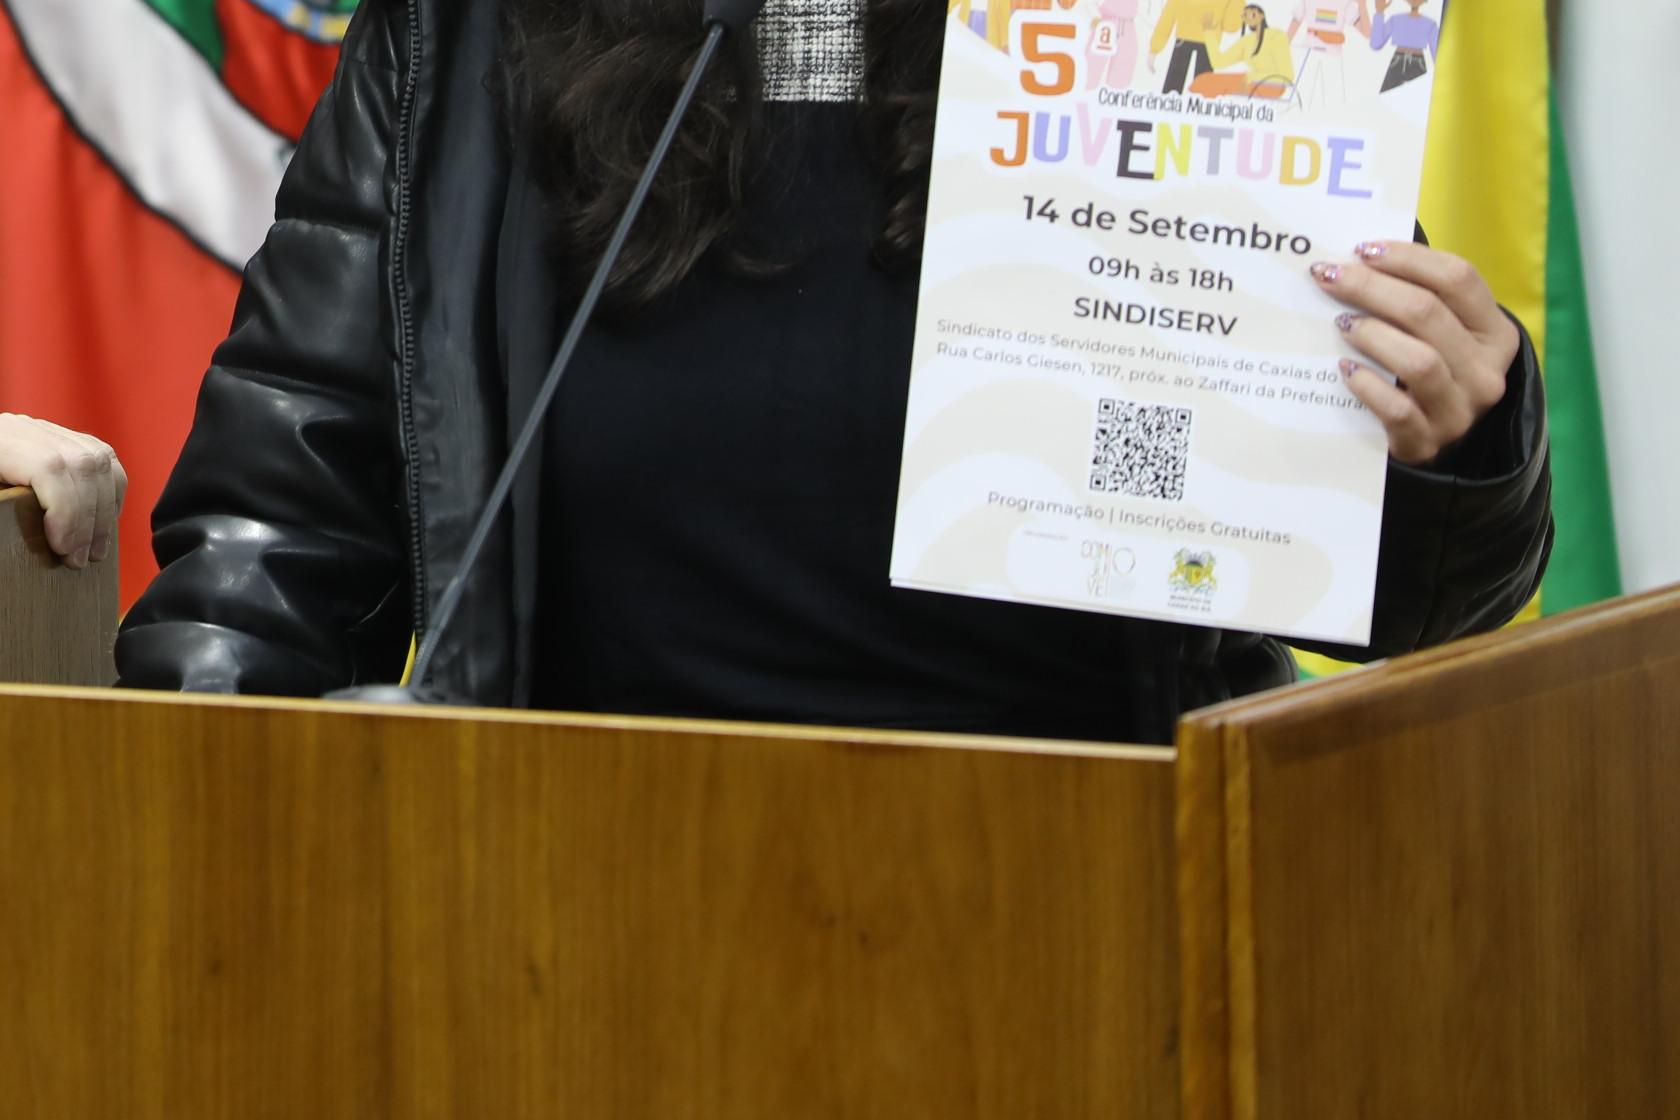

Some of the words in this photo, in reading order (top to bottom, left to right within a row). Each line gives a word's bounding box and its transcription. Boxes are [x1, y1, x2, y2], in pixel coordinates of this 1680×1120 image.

[1098, 86, 1182, 113] Conferência
[1186, 93, 1252, 123] Municipal
[1256, 106, 1274, 123] da
[989, 102, 1373, 199] JUVENTUDE
[1023, 195, 1060, 224] 14
[1071, 201, 1117, 230] de
[1128, 209, 1312, 256] Setembro
[1088, 255, 1140, 281] 09h
[1150, 261, 1179, 286] às
[1189, 267, 1234, 293] 18h
[1073, 296, 1238, 337] SINDISERV
[937, 318, 1012, 341] Sindicato
[1017, 328, 1046, 346] dos
[1051, 334, 1136, 358] Servidores
[1140, 346, 1229, 369] Municipais
[1233, 357, 1255, 372] de
[1259, 361, 1312, 380] Caxias
[1316, 369, 1339, 384] do
[937, 341, 968, 359] Rua
[972, 346, 1023, 367] Carlos
[1027, 353, 1086, 376] Giesen,
[1091, 361, 1125, 381] 1217,
[1129, 369, 1169, 384] próx.
[1174, 375, 1194, 388] ao
[1198, 375, 1251, 395] Zaffari
[1255, 383, 1276, 399] da
[987, 490, 1105, 521] Programação
[1119, 508, 1206, 534] Inscrições
[1210, 519, 1292, 546] Gratuitas
